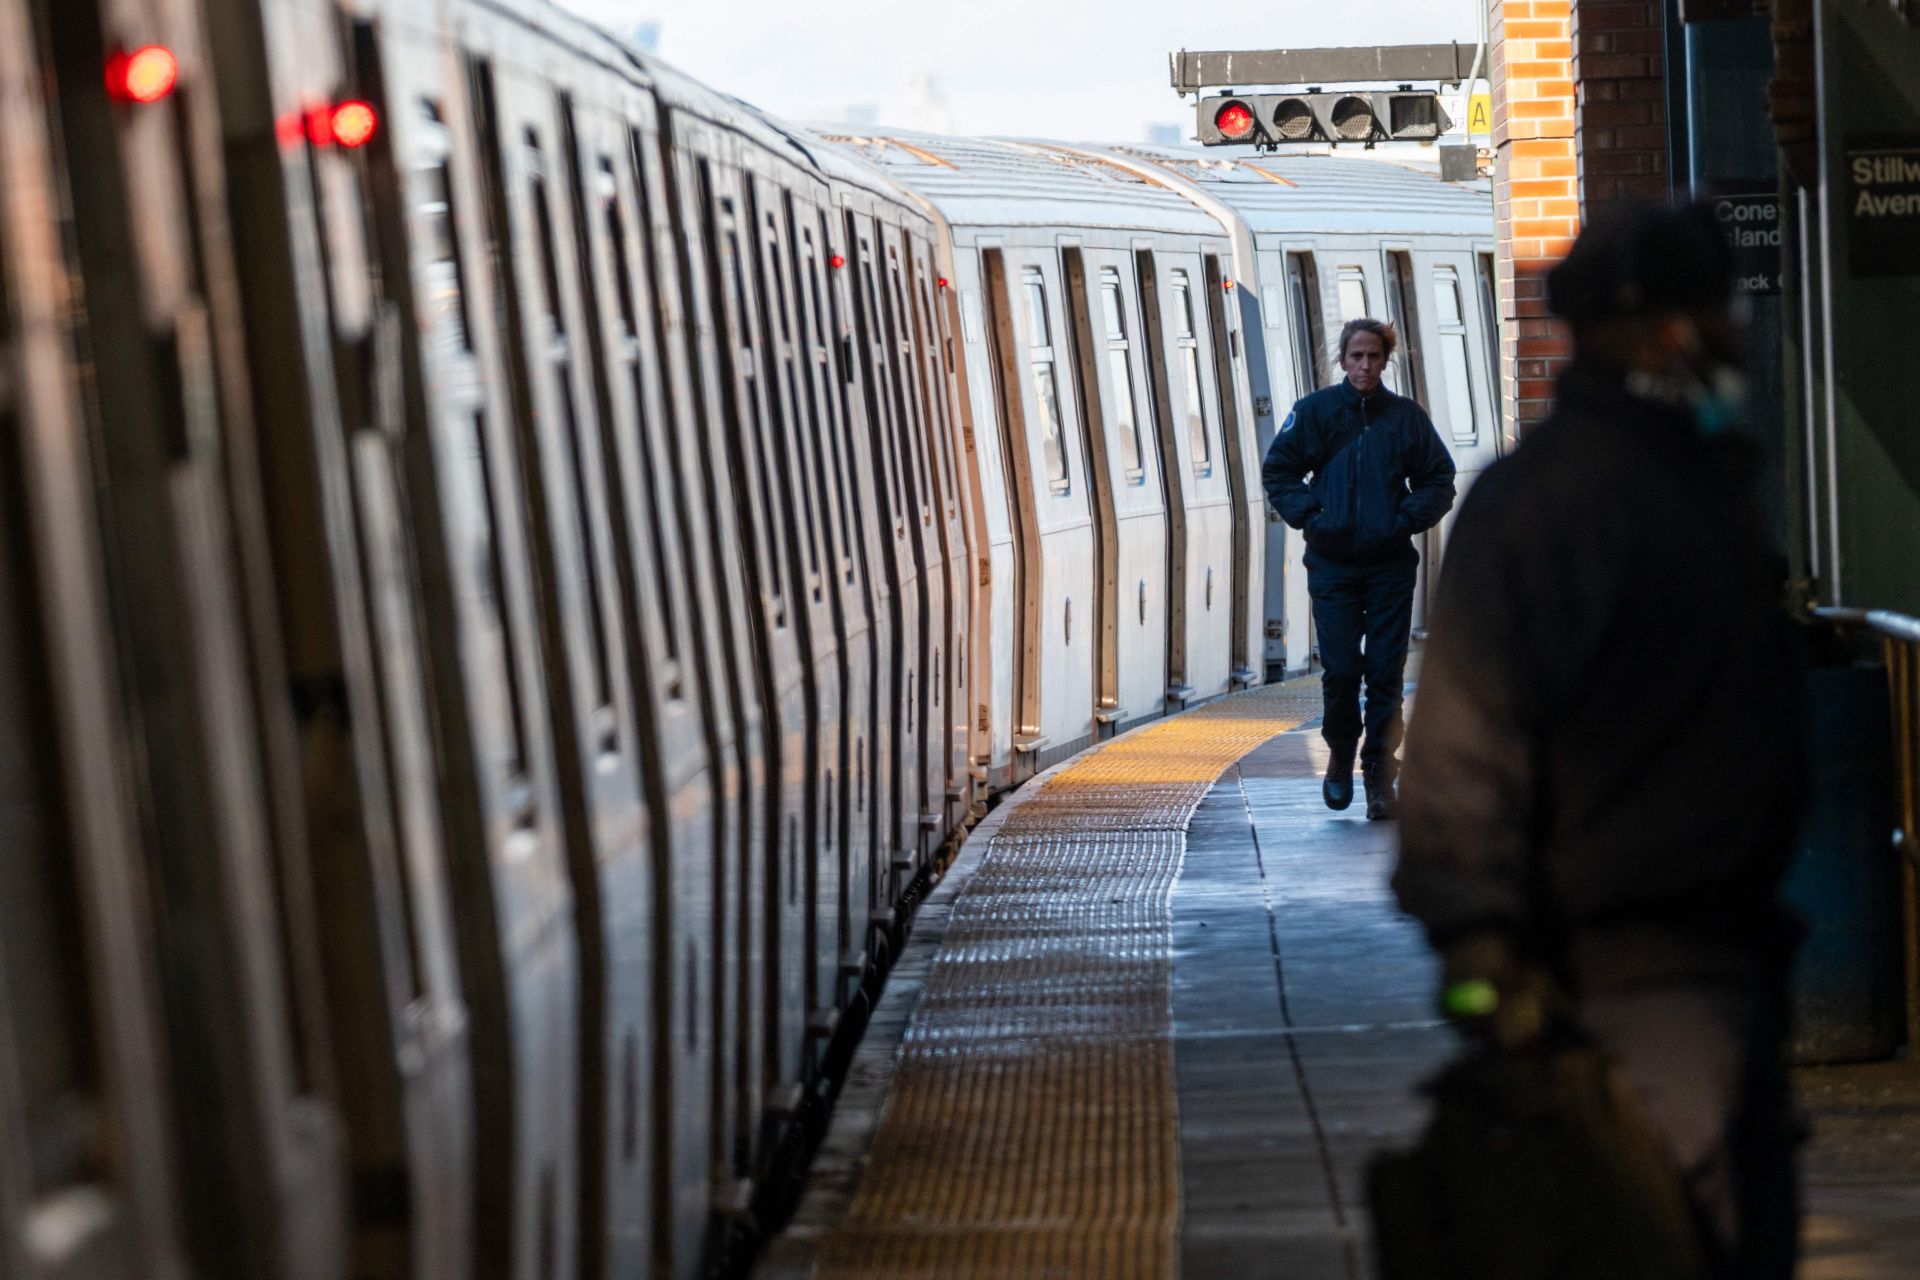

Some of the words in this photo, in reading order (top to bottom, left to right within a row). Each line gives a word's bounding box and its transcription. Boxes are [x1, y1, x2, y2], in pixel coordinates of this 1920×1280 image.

[1472, 102, 1486, 126] A
[1852, 156, 1920, 185] Stillw
[1716, 200, 1781, 223] Cone
[1855, 189, 1920, 217] Aven
[1729, 226, 1782, 248] land
